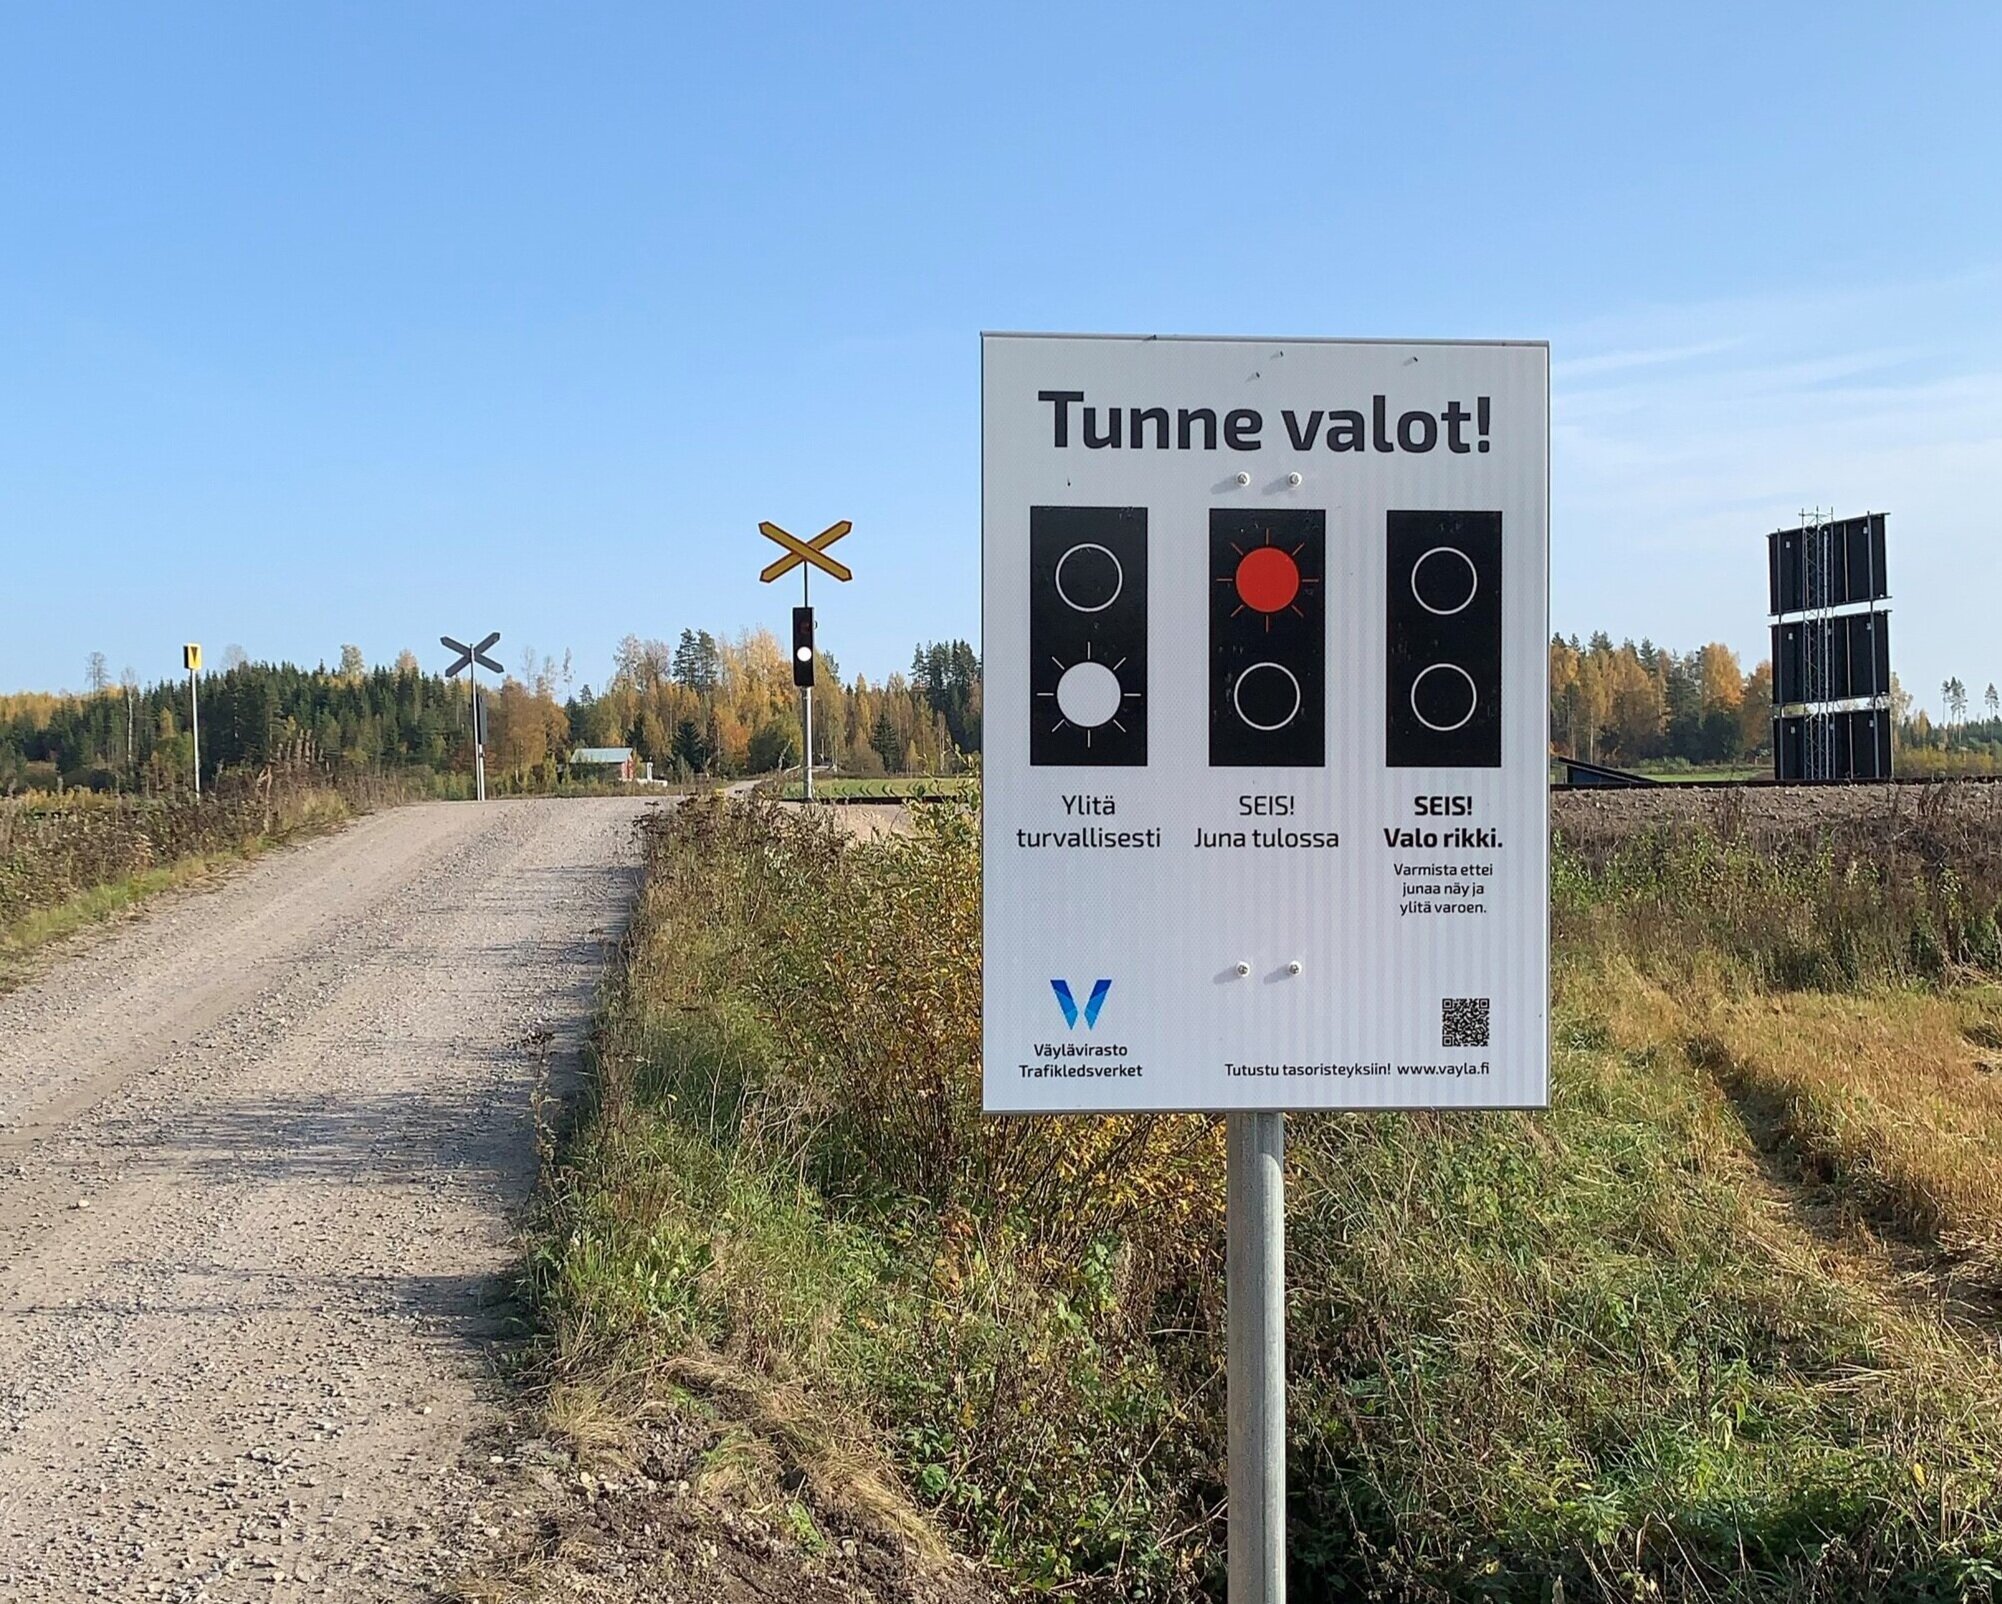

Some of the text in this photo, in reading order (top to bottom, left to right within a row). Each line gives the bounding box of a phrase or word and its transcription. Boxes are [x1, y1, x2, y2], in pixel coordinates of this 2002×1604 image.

[1038, 391, 1490, 453] Tunne valot!
[1062, 795, 1115, 815] Ylitä
[1240, 796, 1294, 815] SEIS!
[1415, 796, 1472, 816] SEIS!
[1016, 828, 1160, 847] turvallisesti
[1194, 828, 1338, 847] Juna tulossa
[1384, 828, 1502, 847] Valo rikki.
[1394, 864, 1492, 876] Varmista ettei
[1403, 882, 1484, 897] junaa näy ja
[1400, 901, 1486, 916] ylitä varoen.
[1034, 1044, 1127, 1059] Väylävirasto
[1019, 1064, 1142, 1077] Trafikledsverket
[1225, 1062, 1489, 1078] Tutustu tasoristeyksiin! www.vayla.fi
